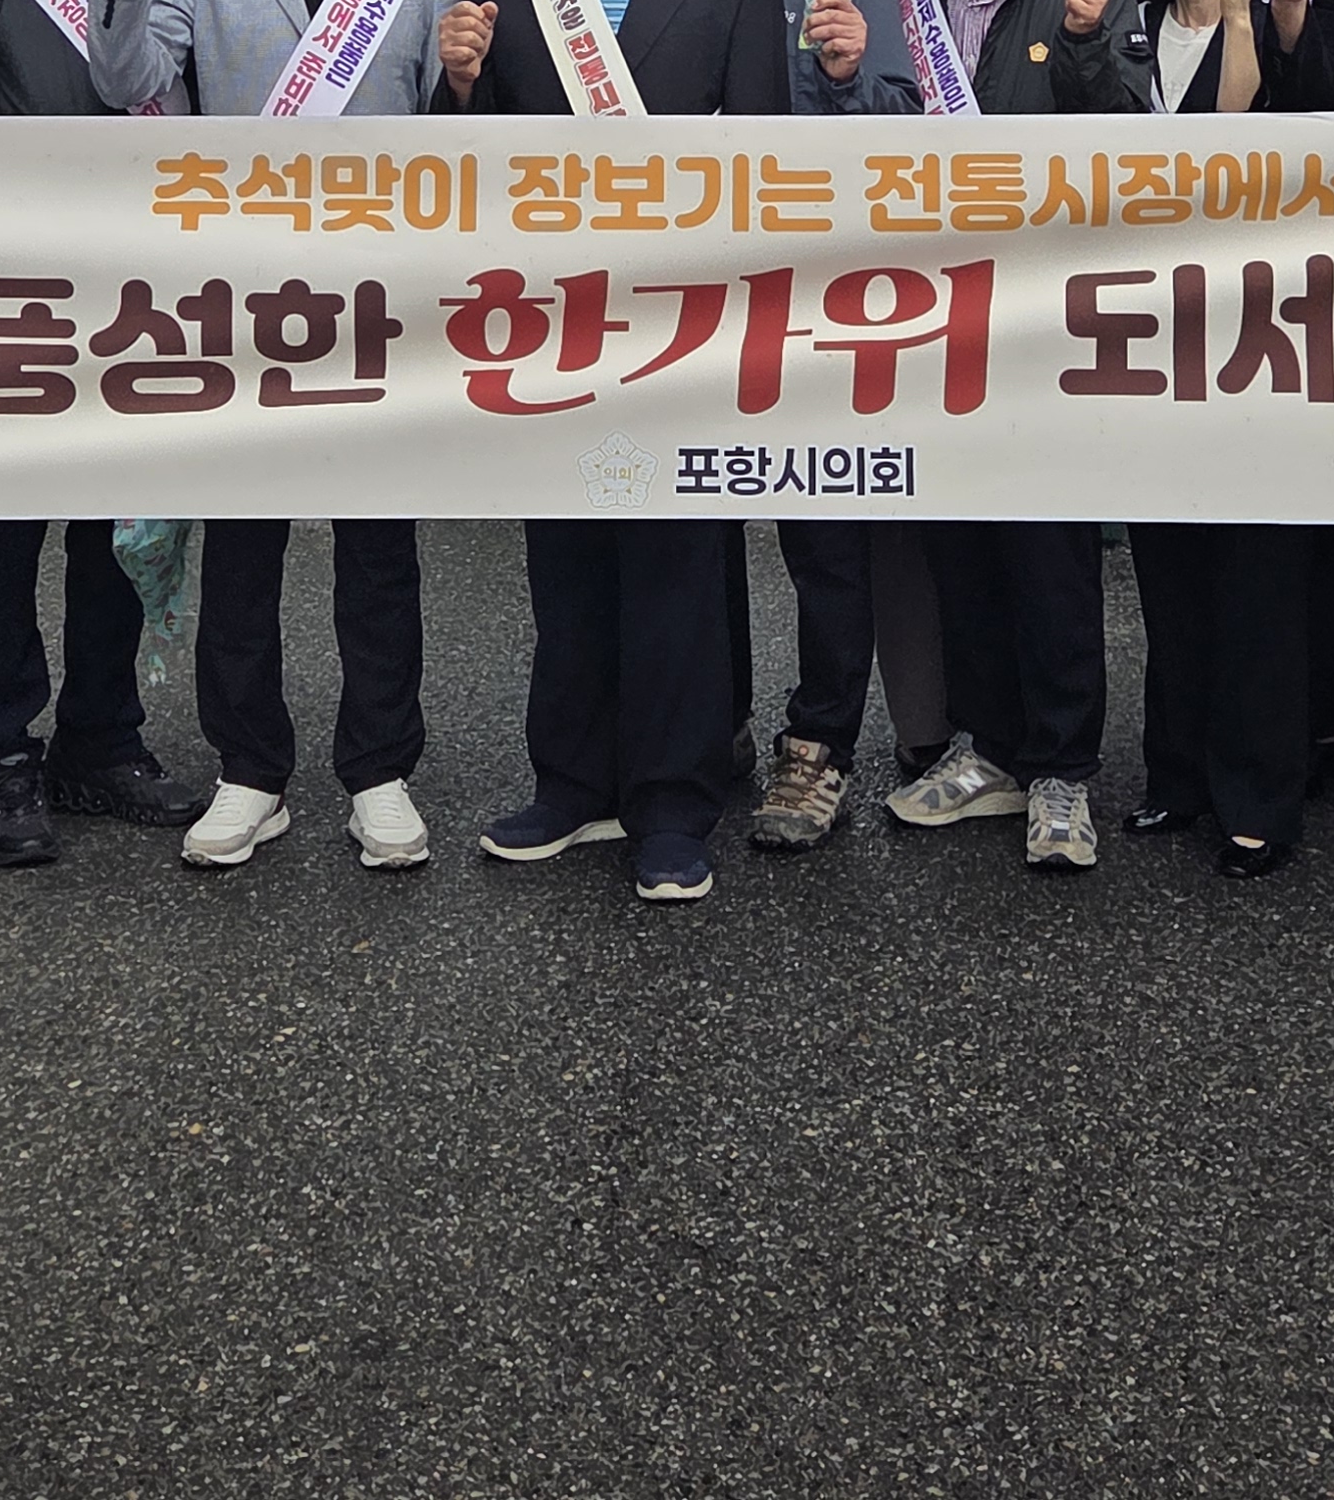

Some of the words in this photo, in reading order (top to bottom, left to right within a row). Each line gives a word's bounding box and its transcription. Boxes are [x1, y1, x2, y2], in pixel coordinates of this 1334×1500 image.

[568, 30, 627, 116] 전통시
[152, 152, 479, 234] 추석맞이
[507, 152, 836, 233] 장보기는
[438, 258, 996, 417] 한가위
[675, 446, 915, 497] 포항시의회
